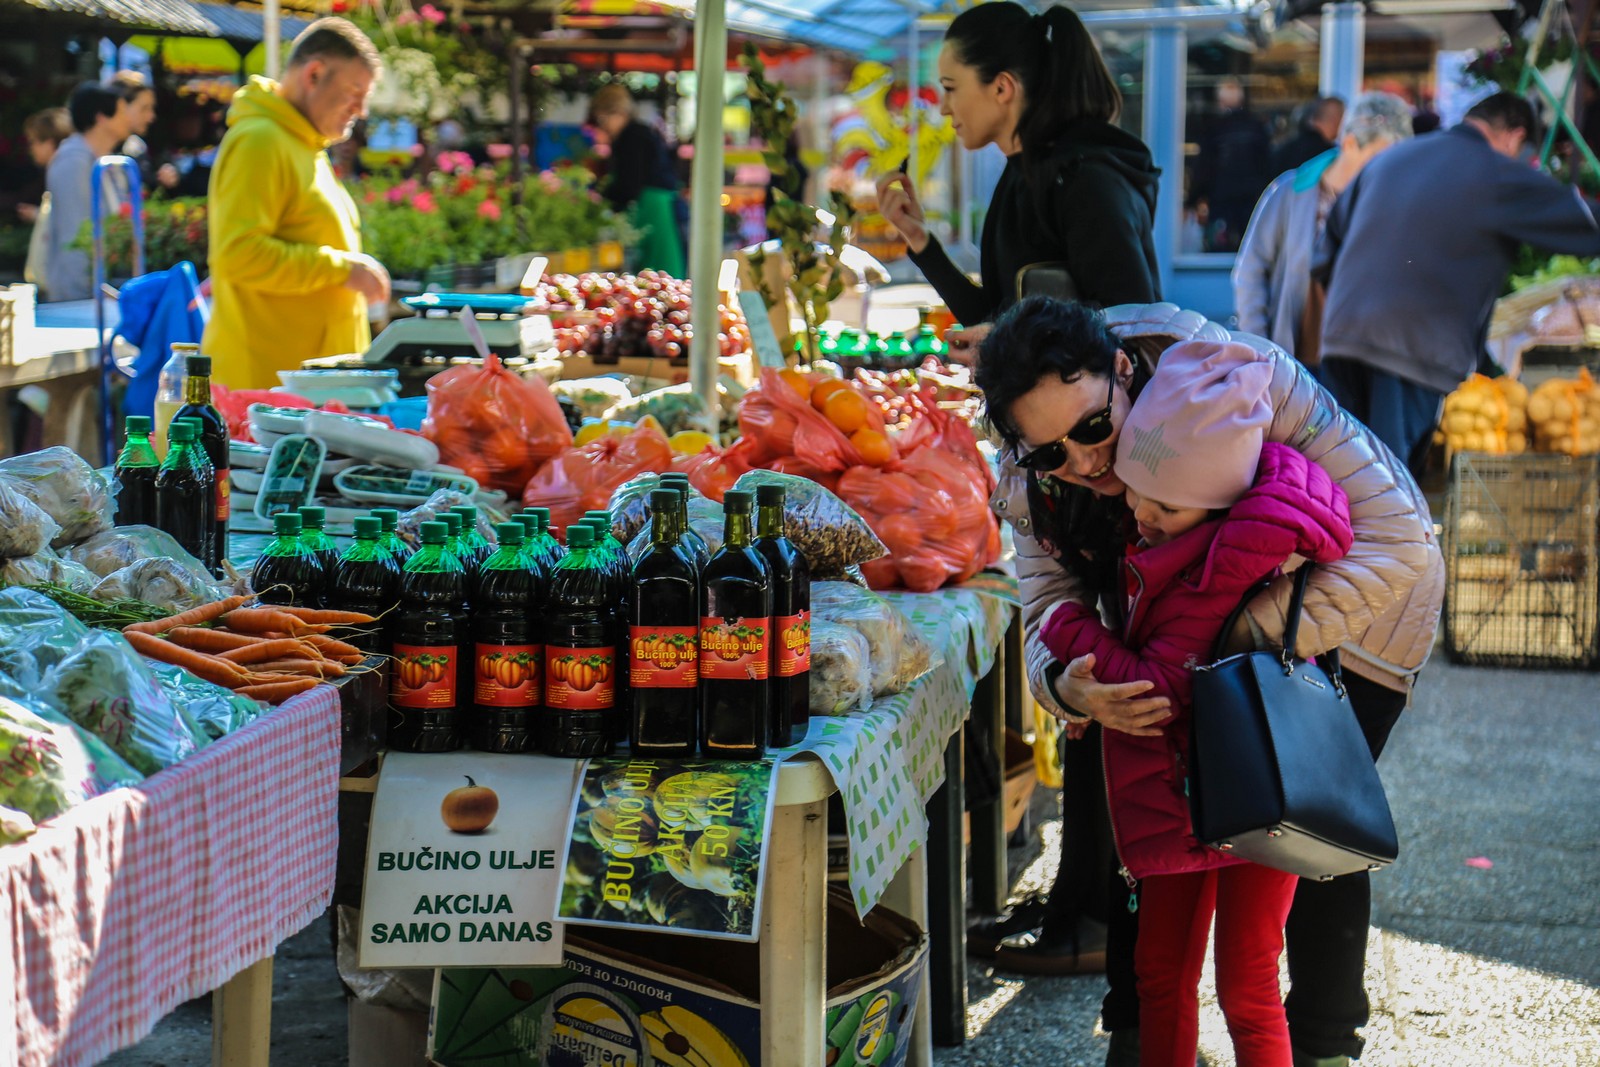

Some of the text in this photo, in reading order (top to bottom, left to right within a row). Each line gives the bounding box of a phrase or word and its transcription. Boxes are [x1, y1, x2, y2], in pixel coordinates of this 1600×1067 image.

[636, 649, 698, 661] Bučino ulje
[701, 640, 763, 653] Bučino ulje
[602, 758, 660, 903] BUČINO ULJE
[656, 778, 697, 861] AKCIJA
[701, 785, 737, 858] 50 KN
[377, 847, 556, 872] BUČINO ULJE
[413, 894, 514, 915] AKCIJA
[371, 922, 554, 944] SAMO DANAS
[593, 969, 611, 982] OF
[612, 975, 672, 1002] PRODUCT
[559, 1014, 633, 1046] PREMIUM BANANAS
